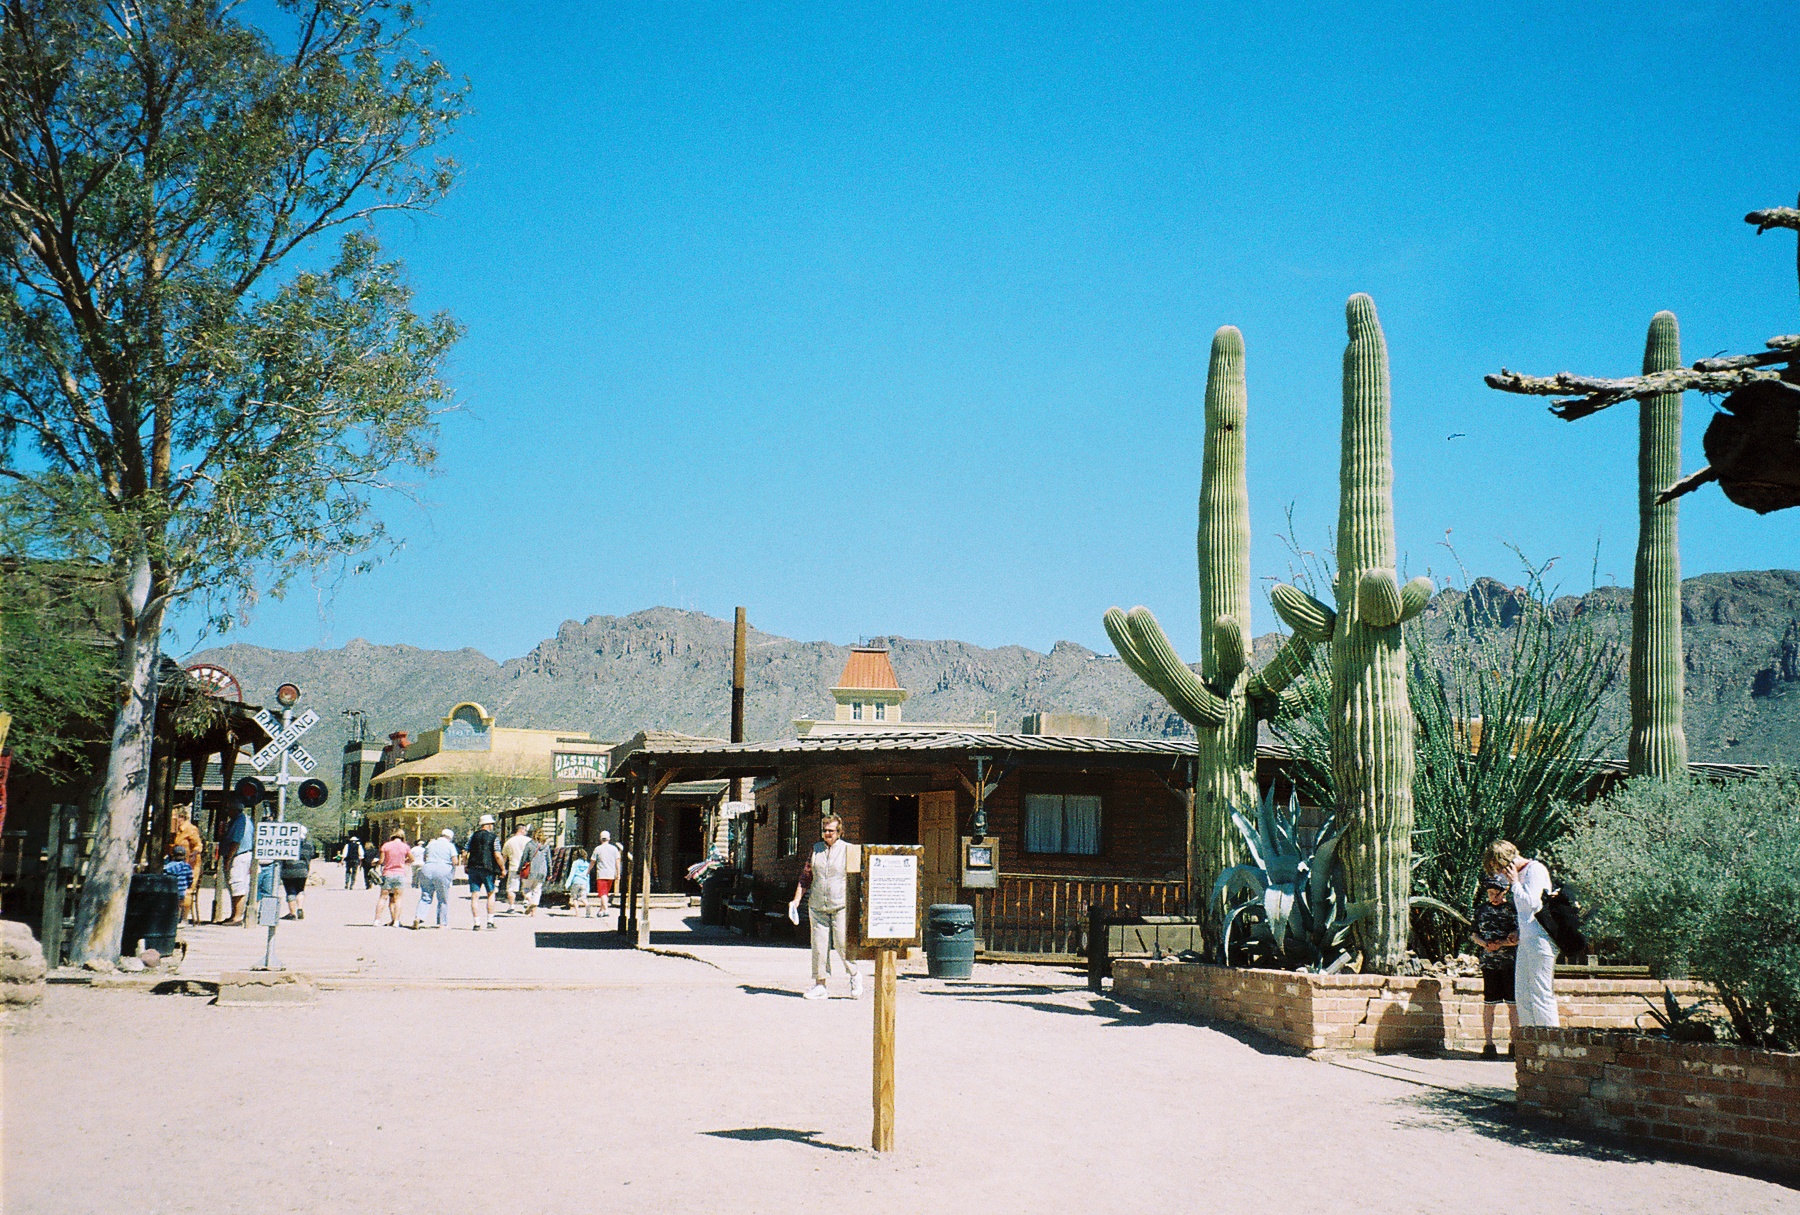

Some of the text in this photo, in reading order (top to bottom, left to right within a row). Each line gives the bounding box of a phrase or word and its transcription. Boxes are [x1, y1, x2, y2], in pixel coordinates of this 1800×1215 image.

[253, 714, 314, 768] CROSSING
[256, 712, 315, 771] RAIL ROAD
[554, 754, 606, 774] OLSEN'S
[258, 825, 299, 837] STOP
[257, 838, 298, 847] ON RED
[256, 848, 298, 857] SIGNAL
